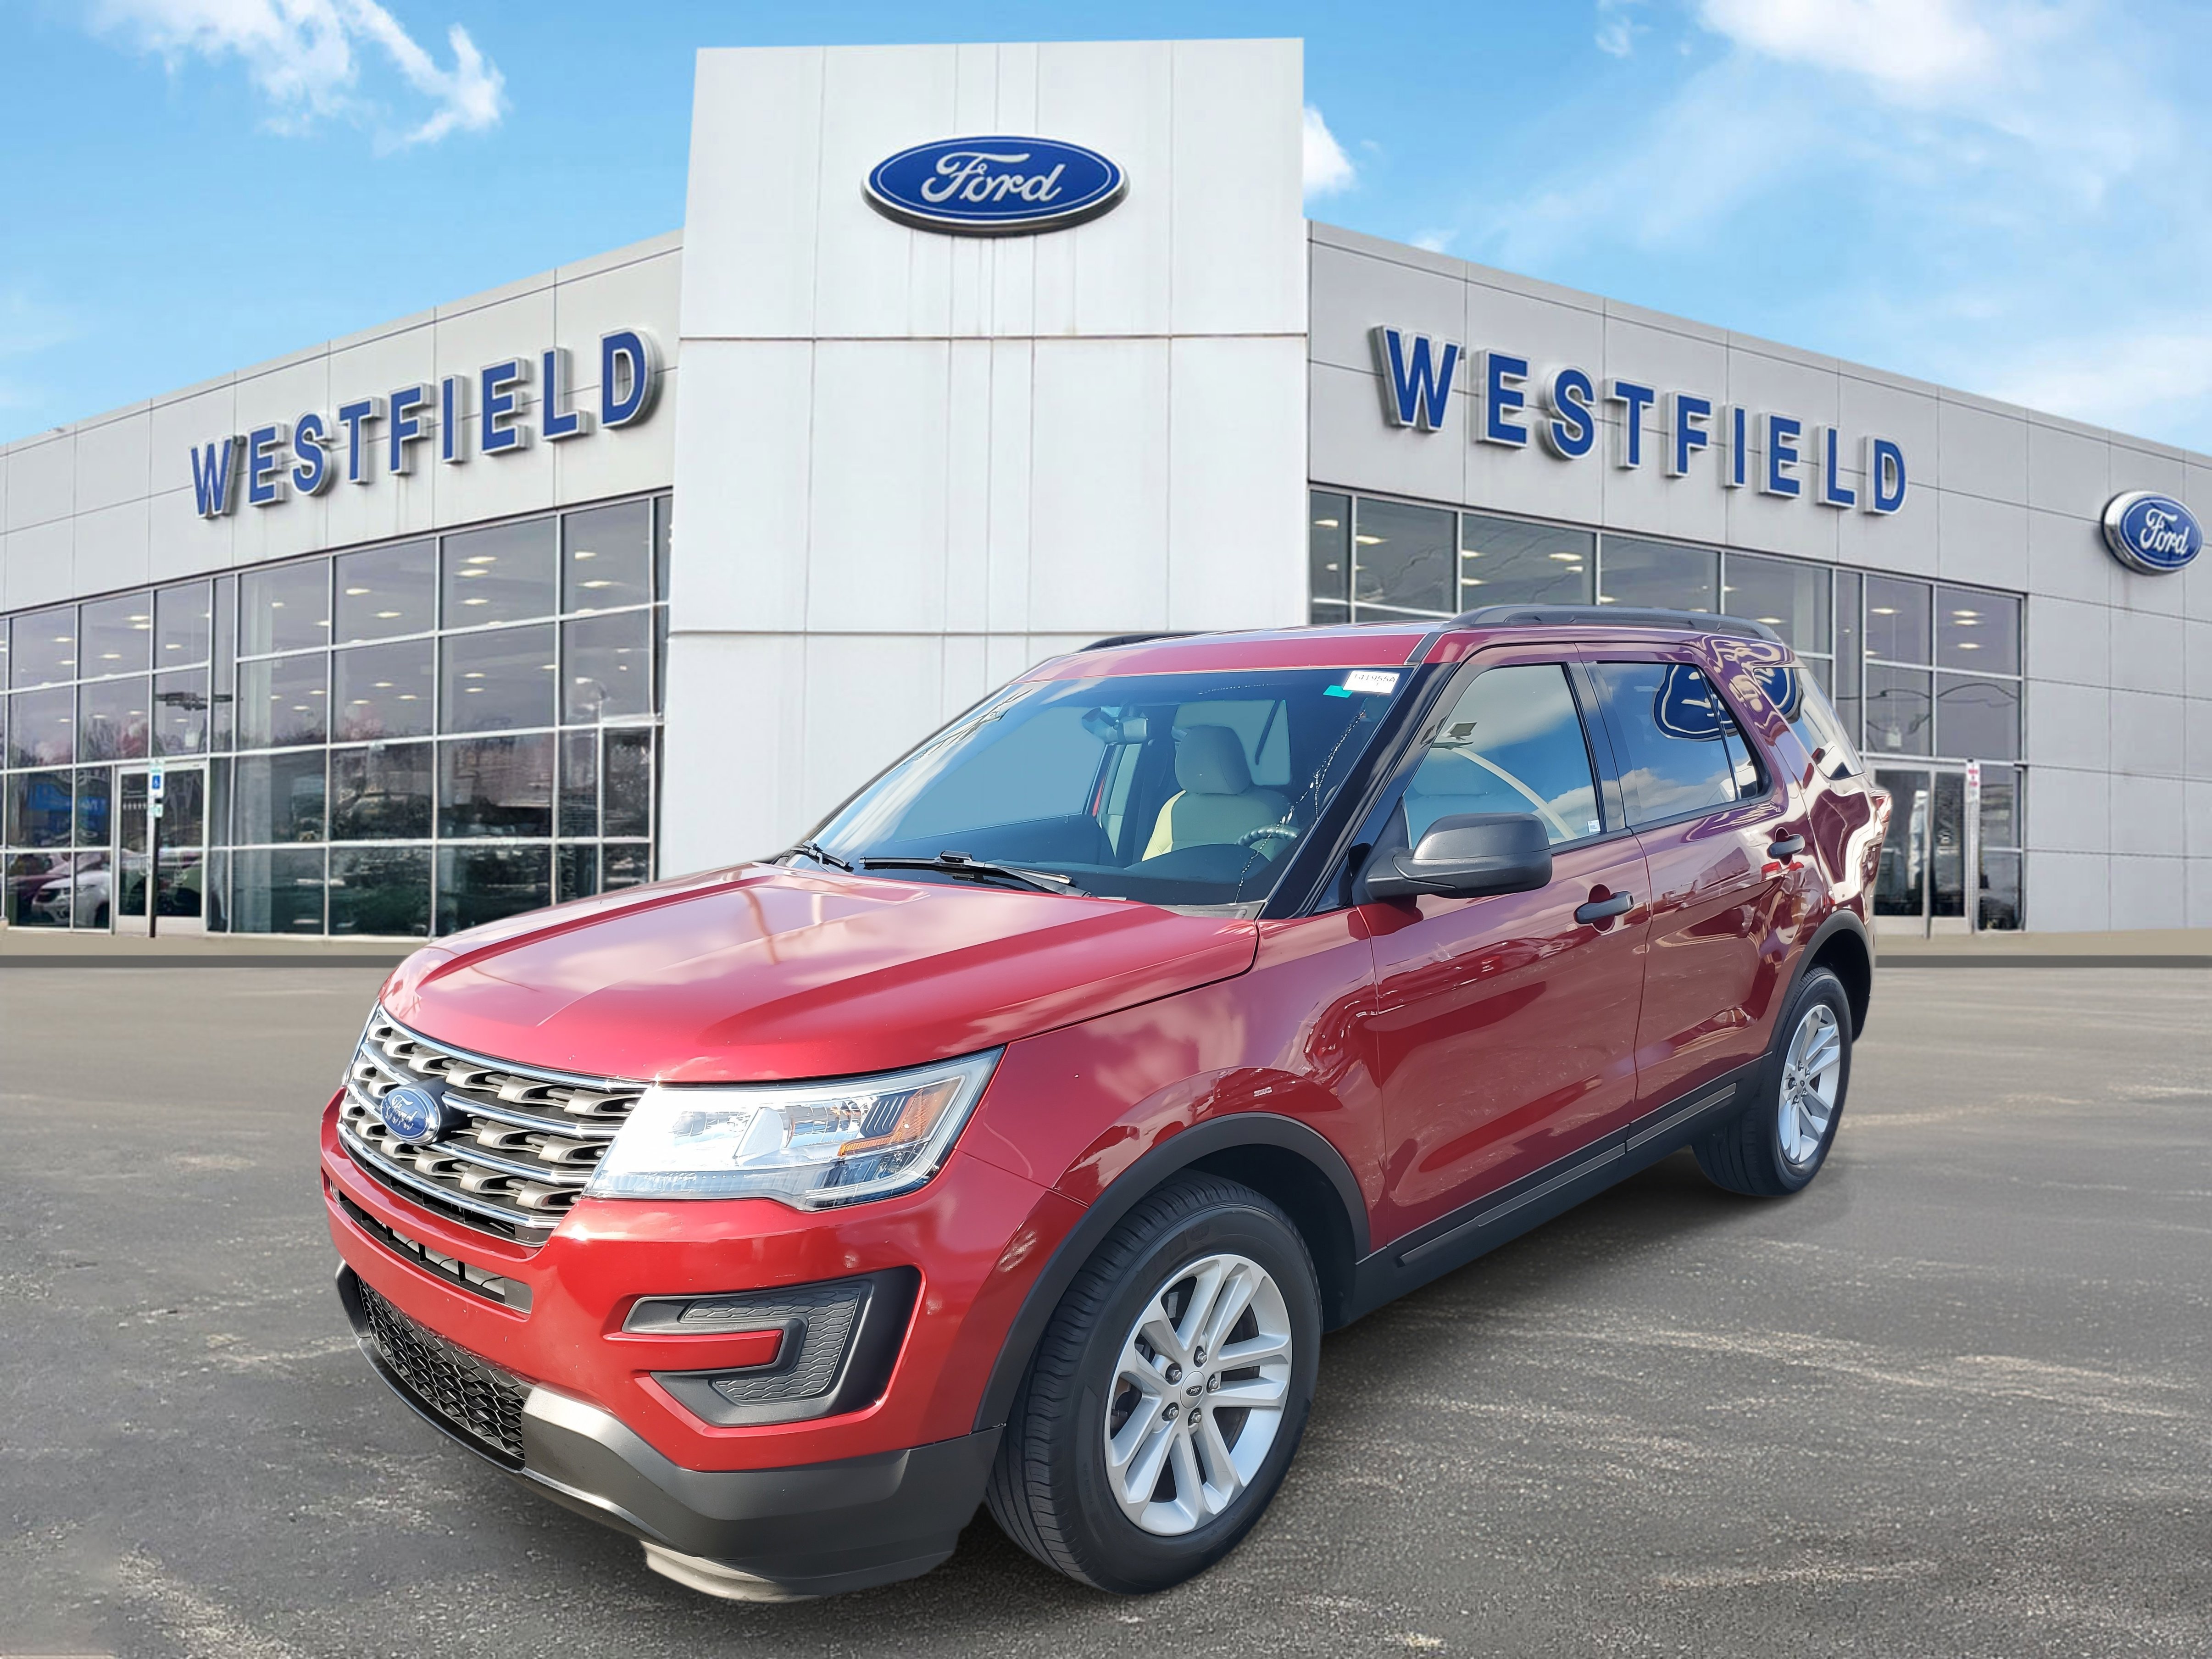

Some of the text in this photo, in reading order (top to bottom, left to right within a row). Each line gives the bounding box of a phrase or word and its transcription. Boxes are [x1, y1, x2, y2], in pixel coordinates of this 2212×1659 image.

[920, 151, 1066, 202] Ford
[189, 328, 661, 518] WESTFIELD
[1376, 324, 1908, 515] WESTFIELD
[2140, 508, 2190, 555] Ford
[384, 1094, 418, 1130] Ford
